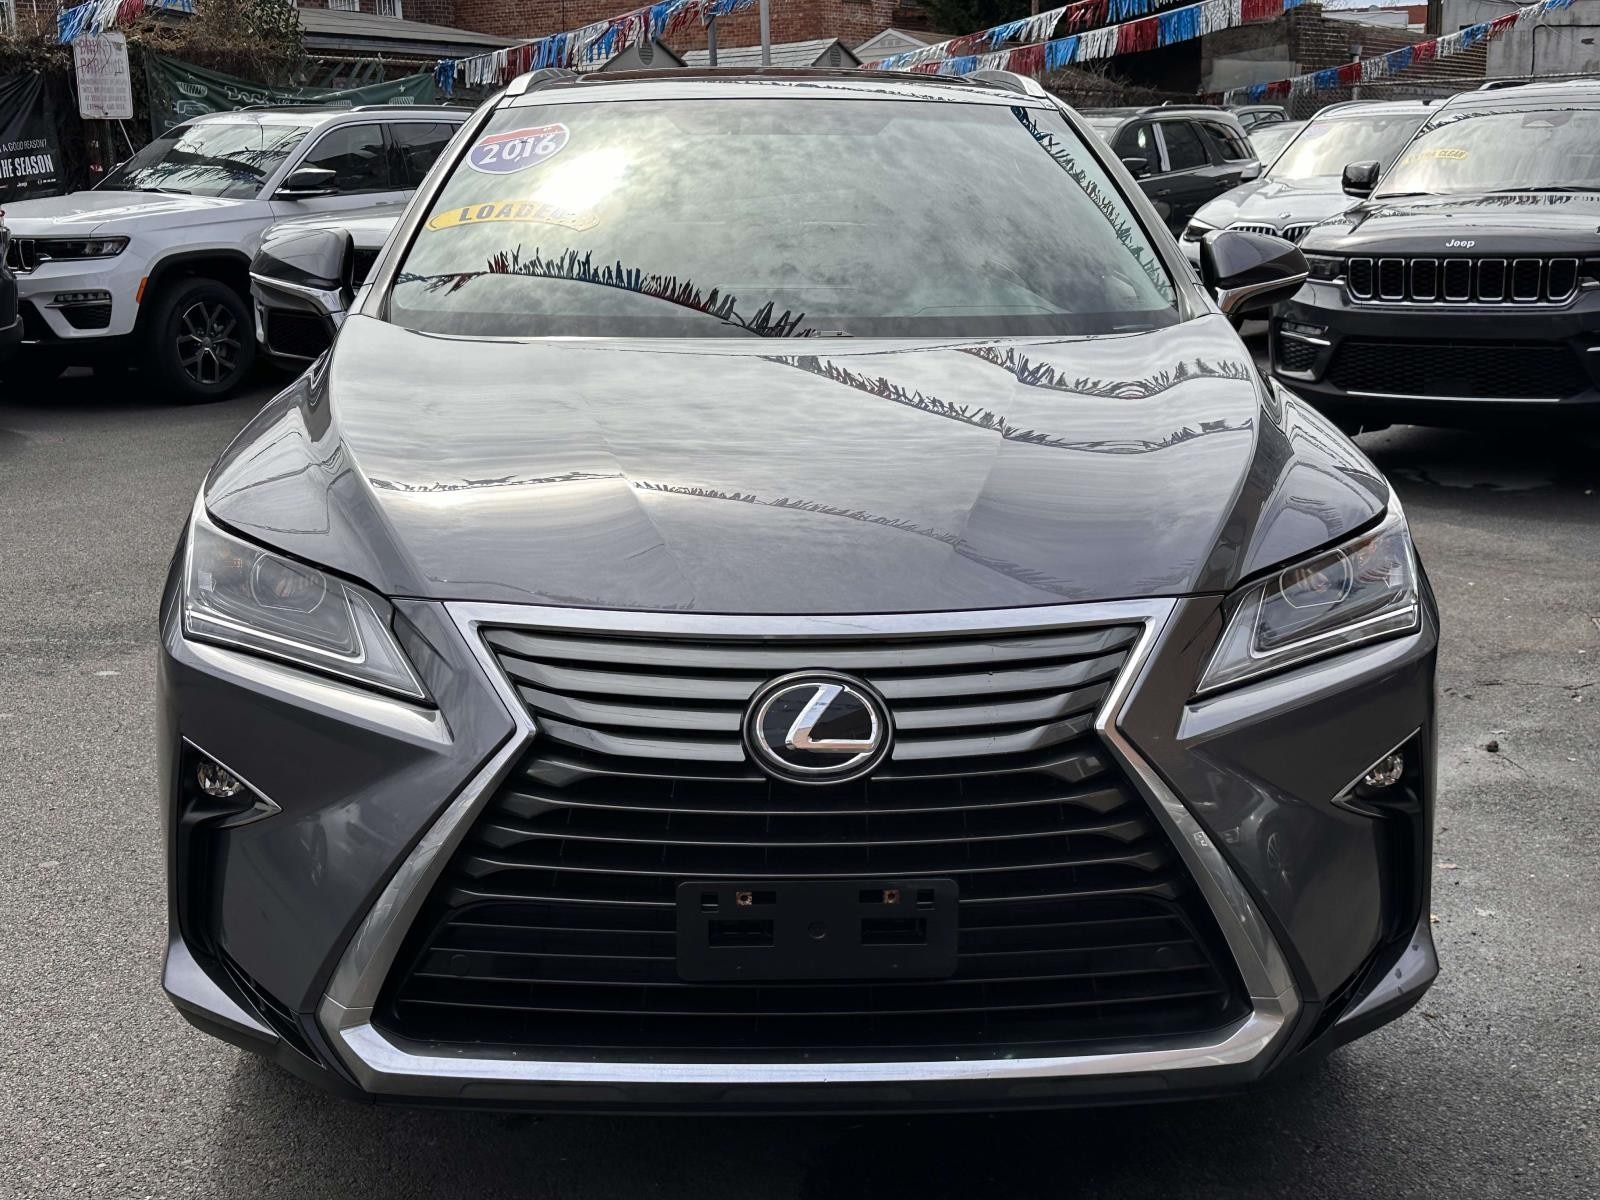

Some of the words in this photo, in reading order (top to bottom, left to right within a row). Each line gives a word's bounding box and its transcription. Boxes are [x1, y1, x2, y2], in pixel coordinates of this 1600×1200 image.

[479, 133, 557, 165] 2016
[0, 158, 14, 179] HE
[15, 154, 54, 177] SEASON
[1445, 239, 1475, 249] Jeep
